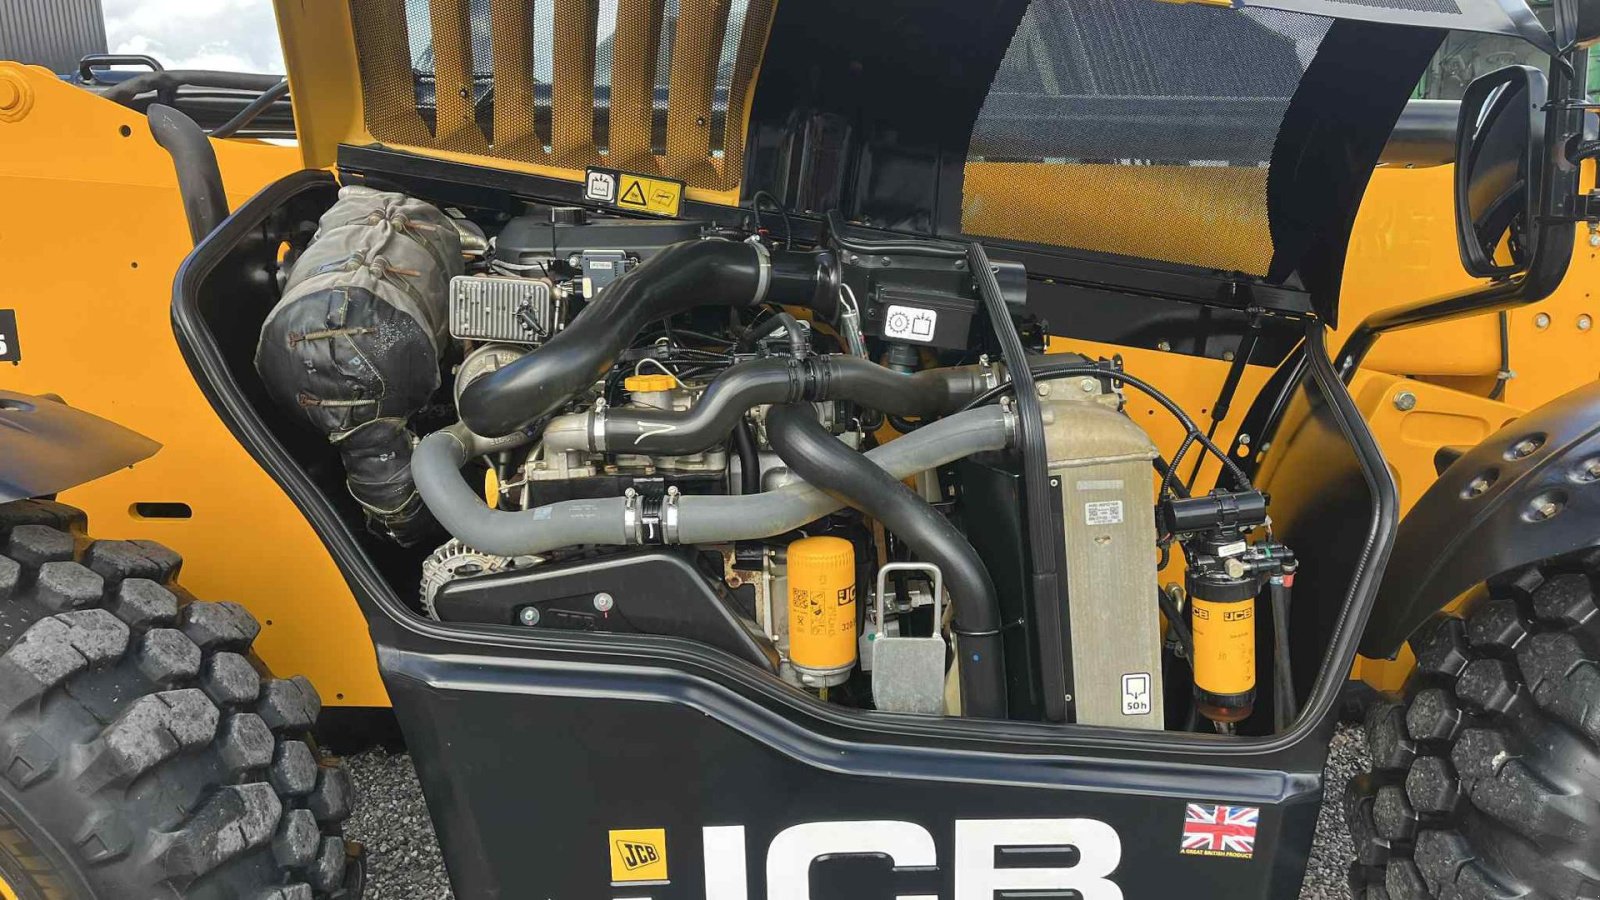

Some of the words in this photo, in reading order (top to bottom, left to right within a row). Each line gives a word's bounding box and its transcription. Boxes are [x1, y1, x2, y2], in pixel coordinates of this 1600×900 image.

[1225, 608, 1252, 621] JCB
[612, 818, 1123, 900] JCB
[624, 843, 657, 867] JCB
[1226, 851, 1253, 859] PRODUCT
